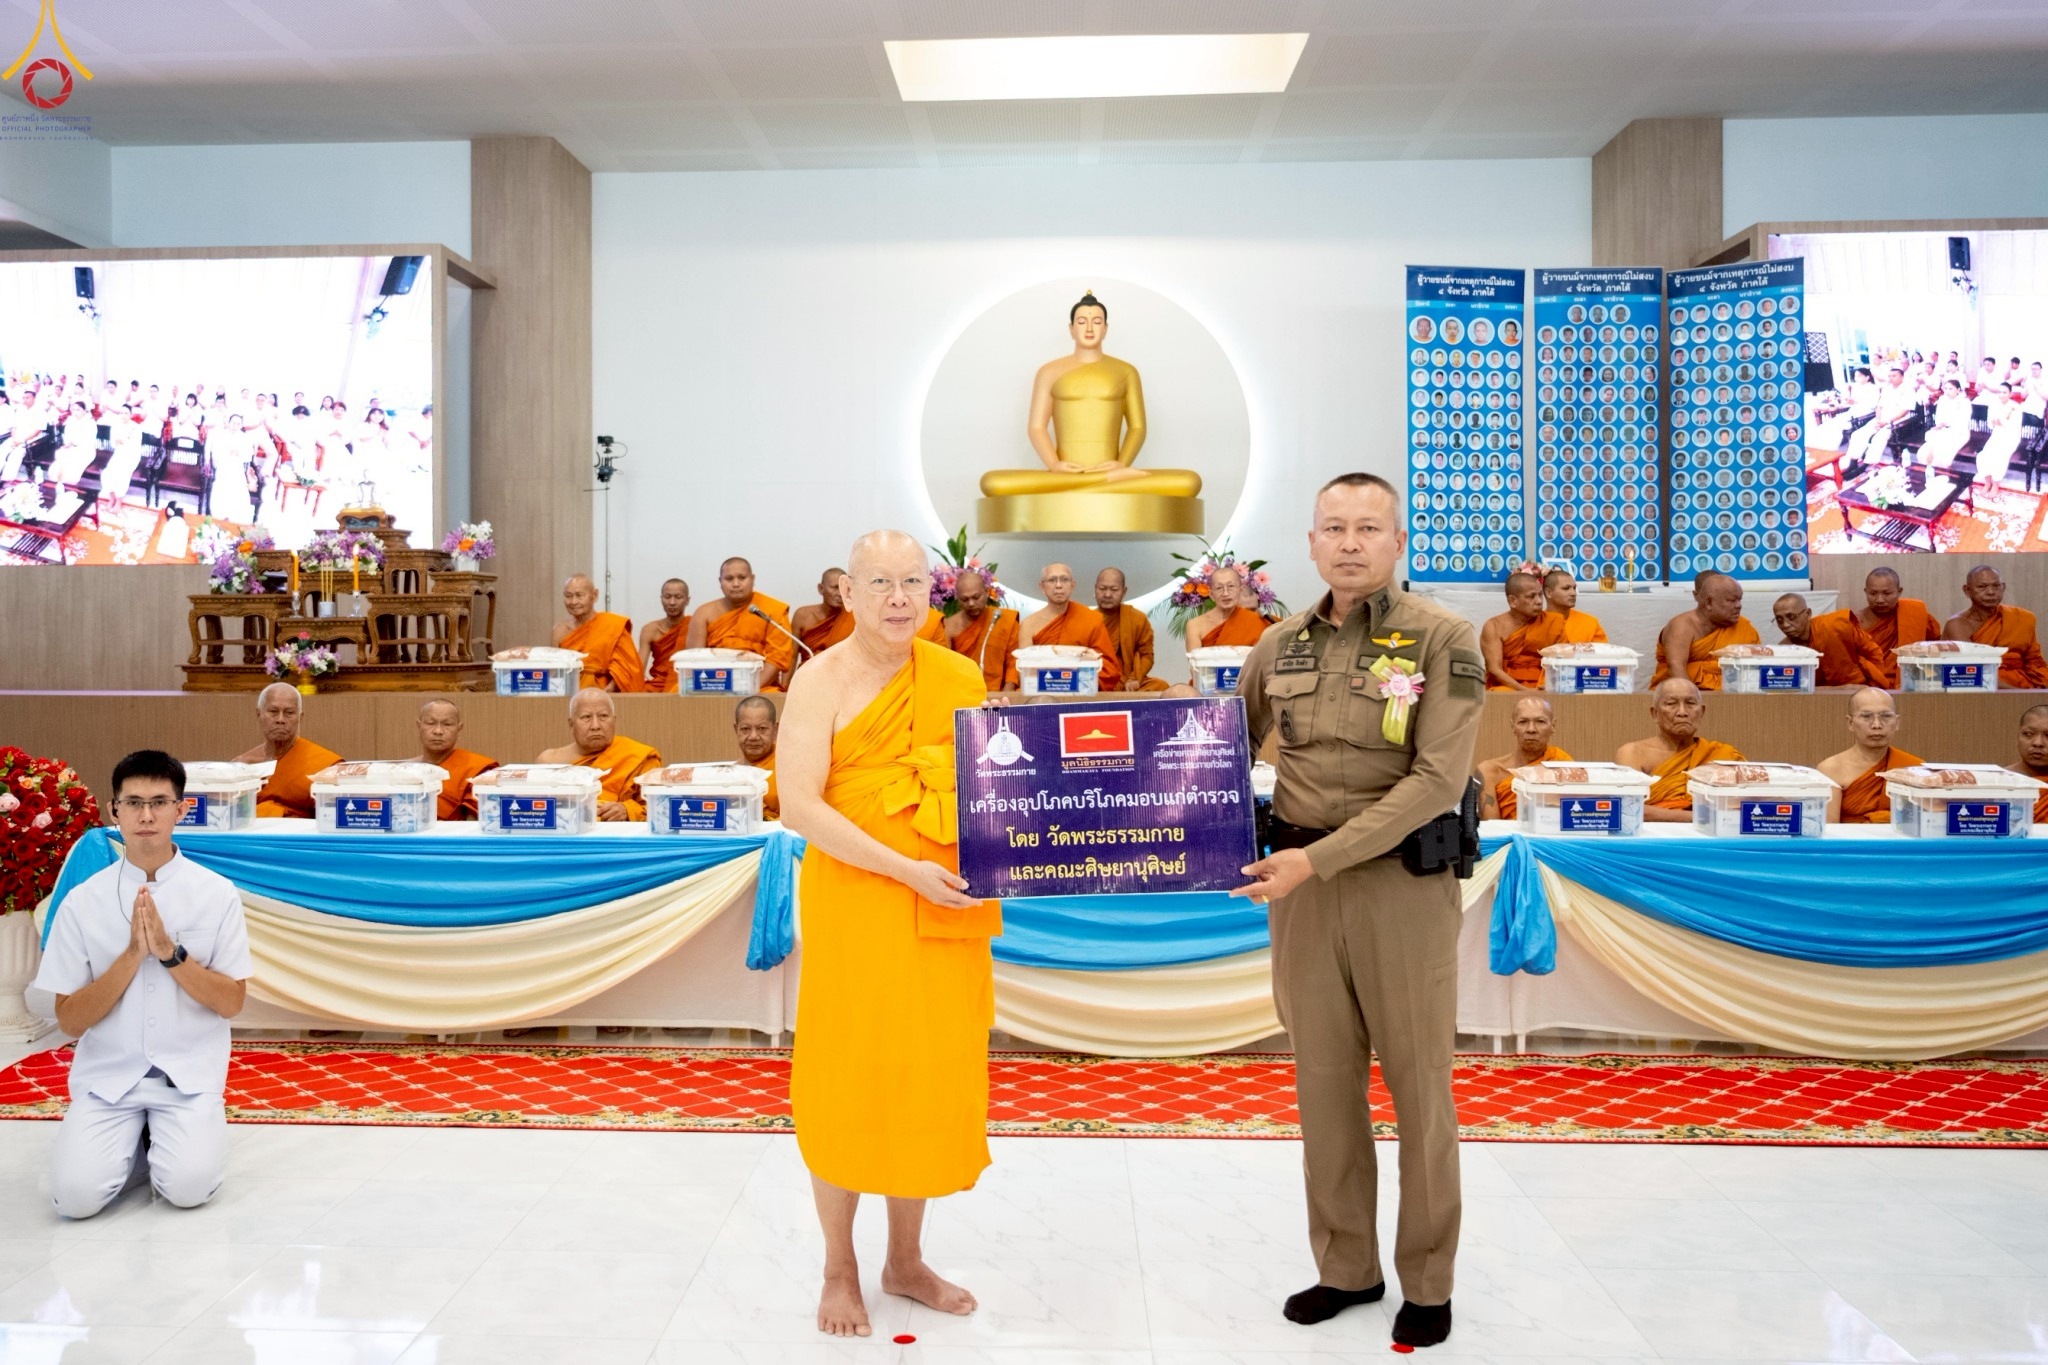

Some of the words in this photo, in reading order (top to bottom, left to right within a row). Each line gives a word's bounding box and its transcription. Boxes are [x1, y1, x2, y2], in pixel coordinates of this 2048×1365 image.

[1447, 286, 1469, 296] จังหวัด
[1472, 286, 1495, 296] ภาคใต้
[1576, 283, 1602, 292] จังหวัด
[1605, 282, 1631, 292] ภาคใต้
[1709, 280, 1737, 292] จังหวัด
[1741, 277, 1768, 288] ภาคใต้
[1061, 757, 1135, 769] มูลนิธิธรรมกาย
[975, 767, 1037, 778] วัดพระธรรมกาย
[970, 786, 1240, 817] เครื่องอุปโภคบริโภคมอบแก่ตำรวจ
[1006, 826, 1039, 848] โดย
[1047, 825, 1185, 847] วัดพระธรรมกาย
[1009, 852, 1187, 882] และคณะศิษยานุศิษย์
